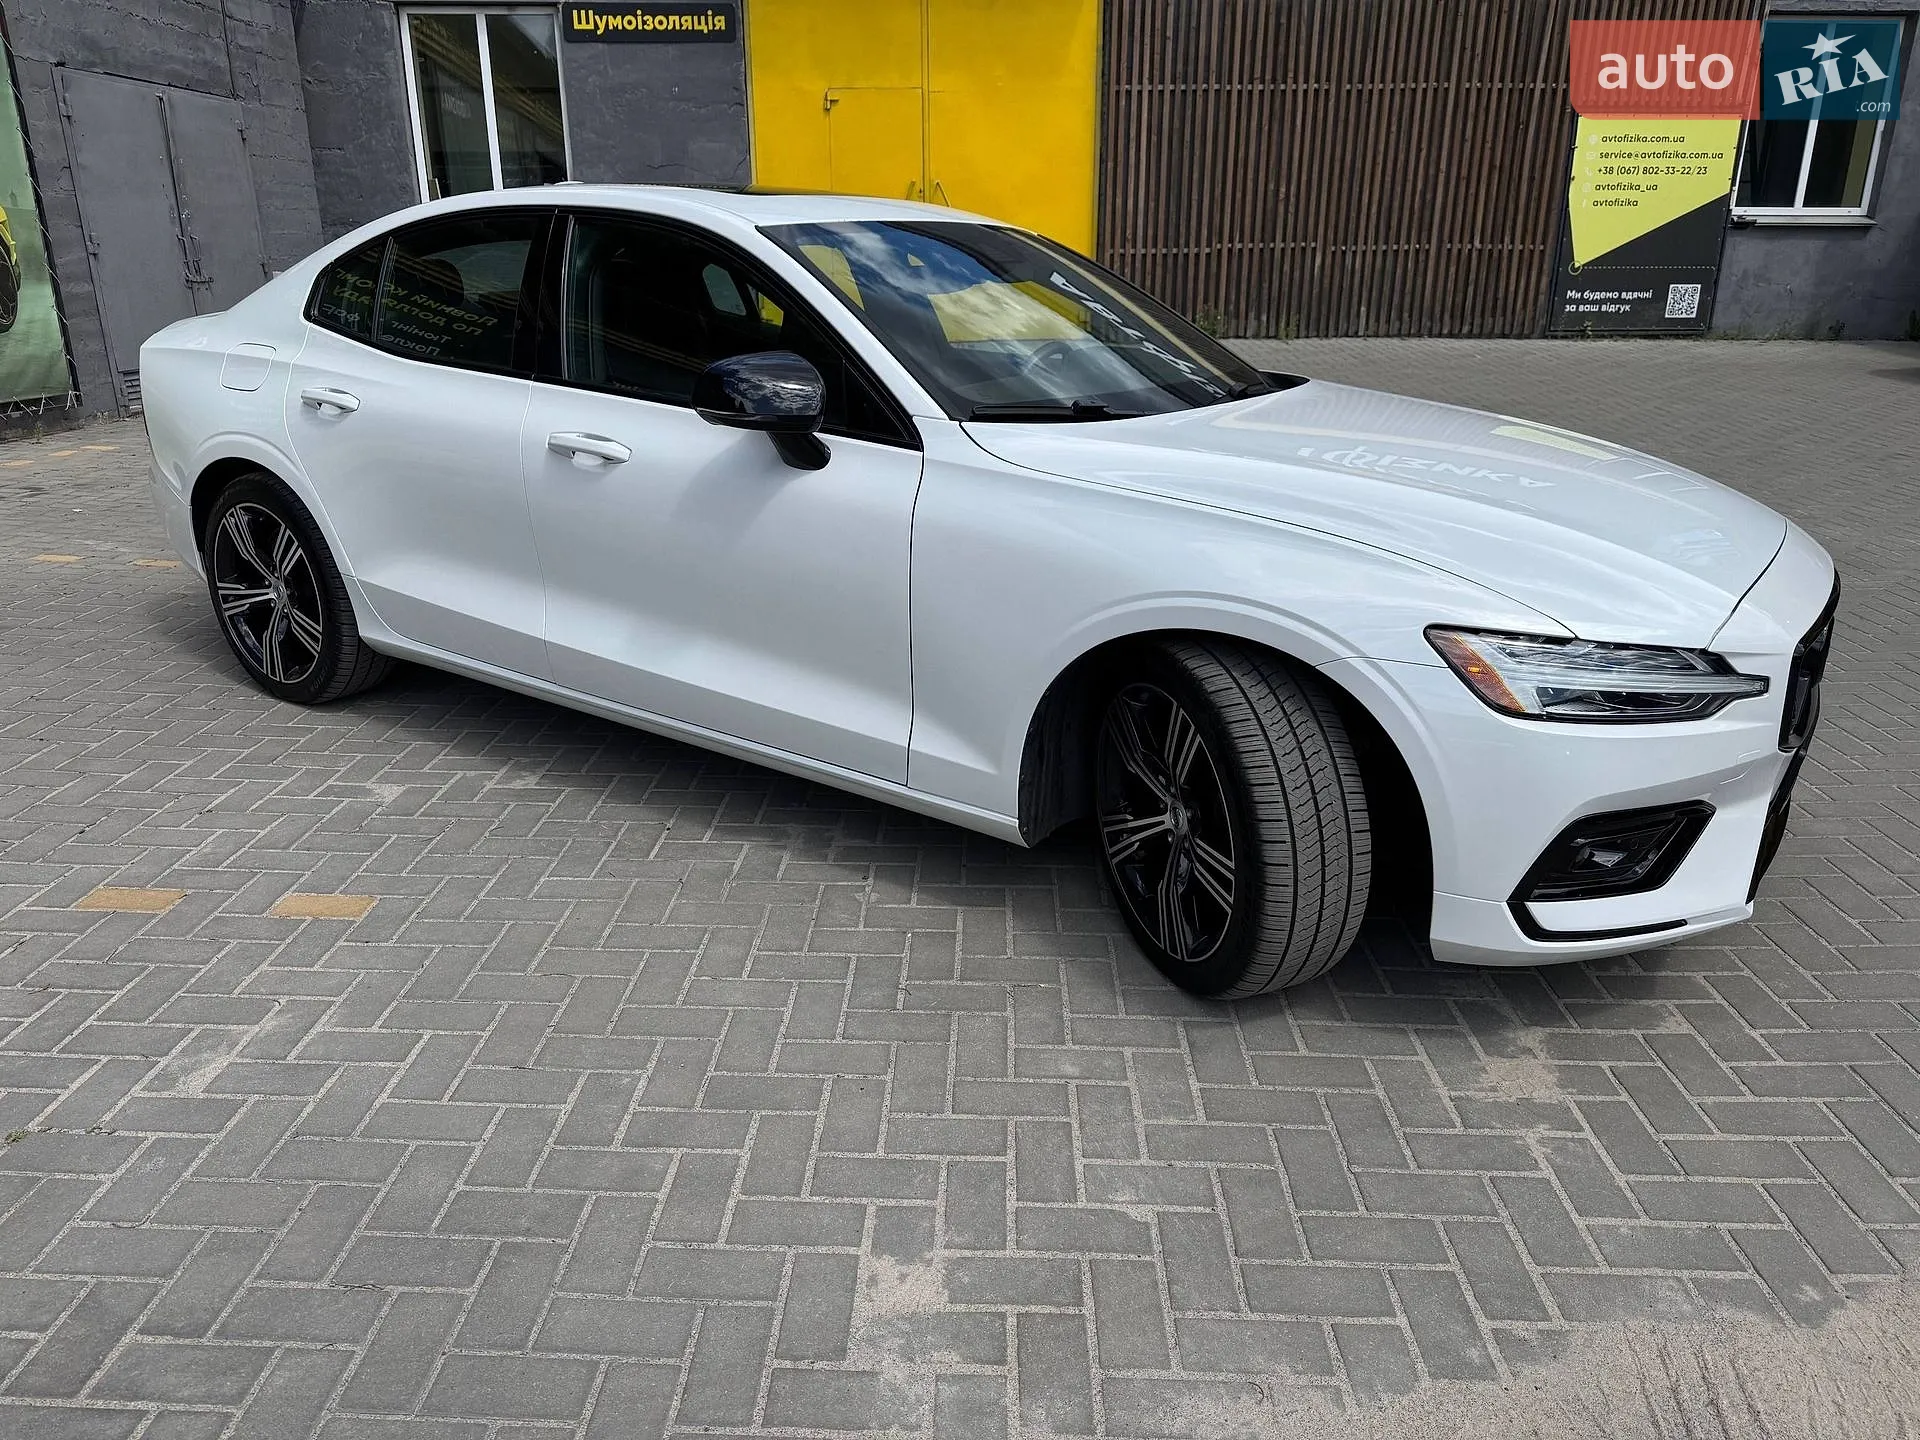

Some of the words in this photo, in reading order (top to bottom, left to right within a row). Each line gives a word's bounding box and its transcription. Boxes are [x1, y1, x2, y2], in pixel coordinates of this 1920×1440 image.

[572, 9, 726, 35] Шумоізоляція
[1601, 134, 1685, 143] avtofizika.com.ua
[1599, 150, 1724, 160] service@avtofizika.com.ua
[1597, 166, 1614, 175] +38
[1616, 165, 1640, 176] (067)
[1642, 166, 1708, 175] 802-33-22/23
[1595, 182, 1658, 192] avtofizika_ua
[1592, 198, 1639, 207] avtofizika
[1566, 290, 1581, 299] Ми
[1583, 290, 1619, 300] будемо
[1621, 289, 1653, 300] вдячні
[1564, 304, 1576, 312] за
[1578, 304, 1599, 312] ваш
[1601, 302, 1631, 313] відгук
